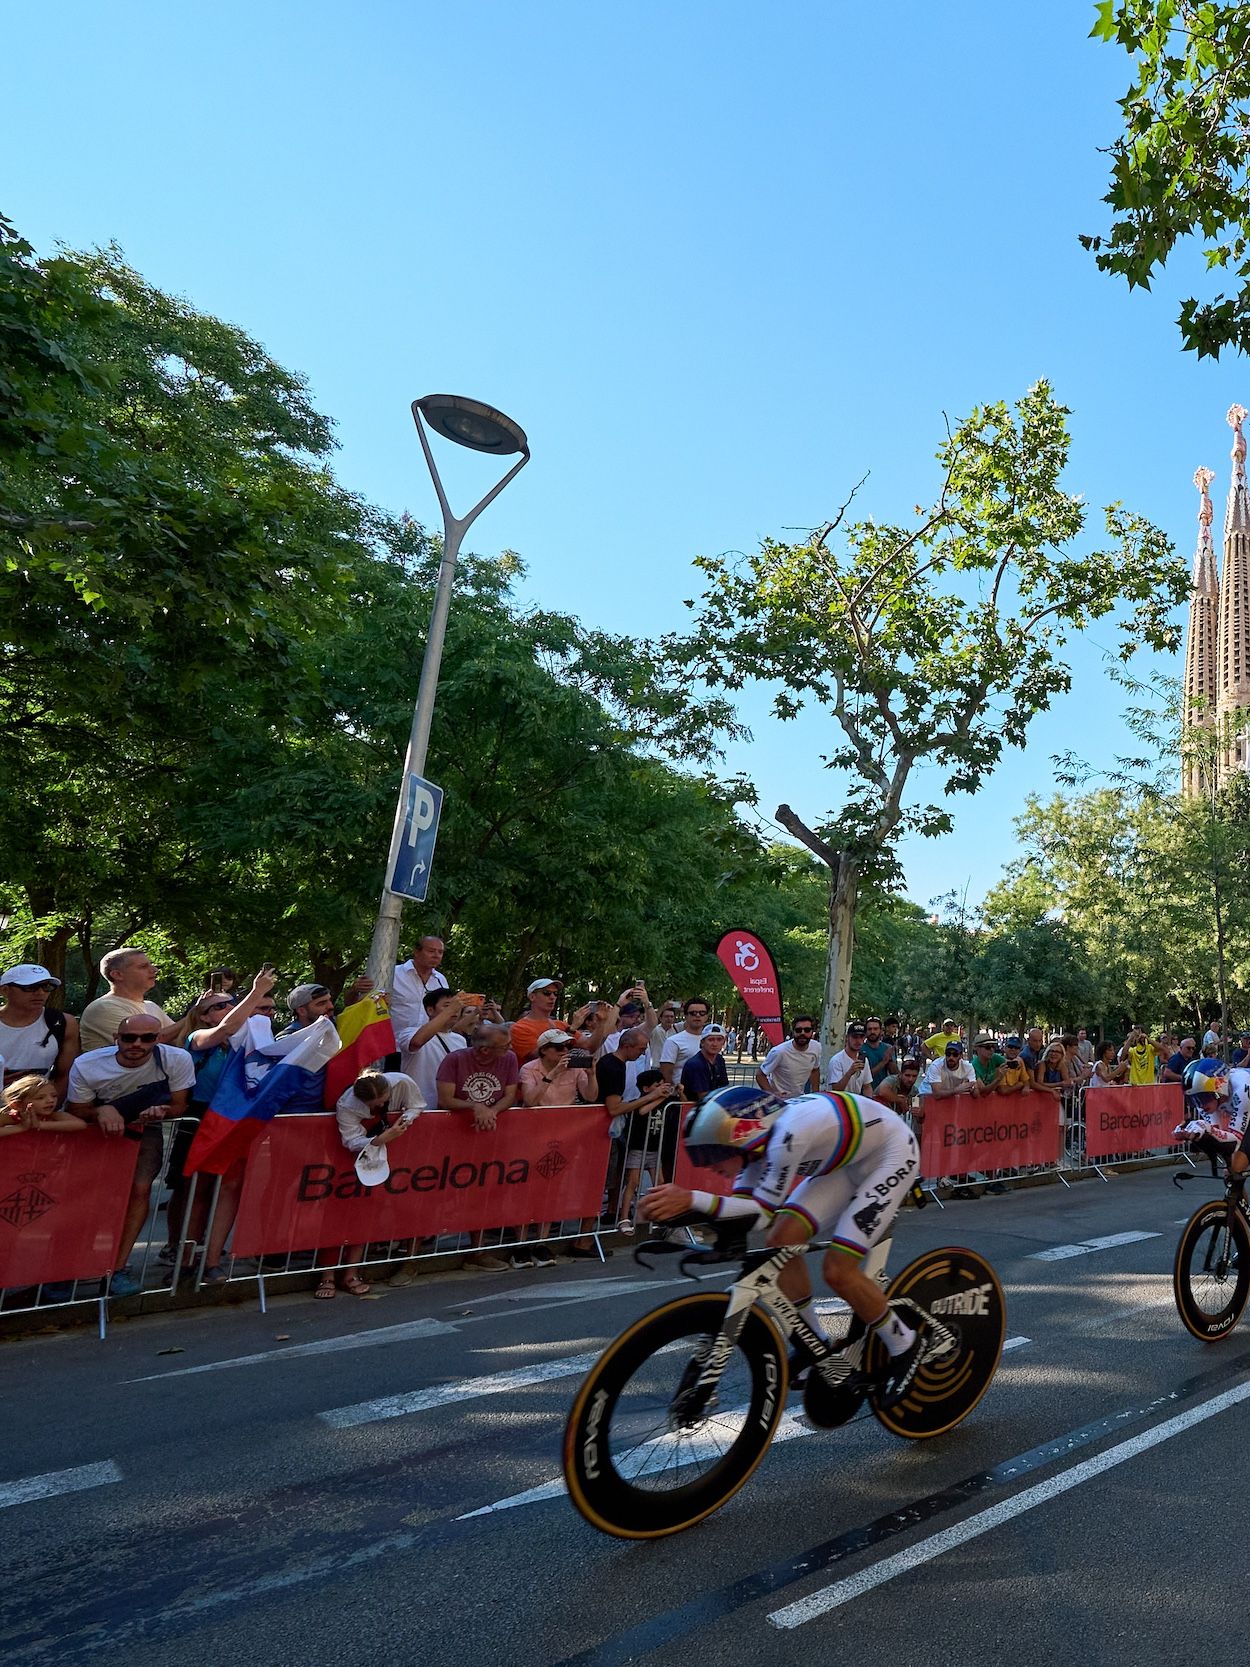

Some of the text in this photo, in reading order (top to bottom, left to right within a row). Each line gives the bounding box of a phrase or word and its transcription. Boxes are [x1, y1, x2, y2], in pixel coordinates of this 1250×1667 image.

[408, 785, 435, 848] P
[944, 1120, 1029, 1148] Barcelona
[1100, 1109, 1163, 1131] Barcelona
[1240, 1111, 1249, 1132] BORA
[297, 1156, 529, 1202] Bacelona
[875, 1158, 918, 1197] BORA
[930, 1282, 995, 1316] OUTRIDE
[773, 1296, 828, 1357] SPECIALIZED
[1207, 1313, 1235, 1333] roval
[763, 1353, 779, 1432] roval
